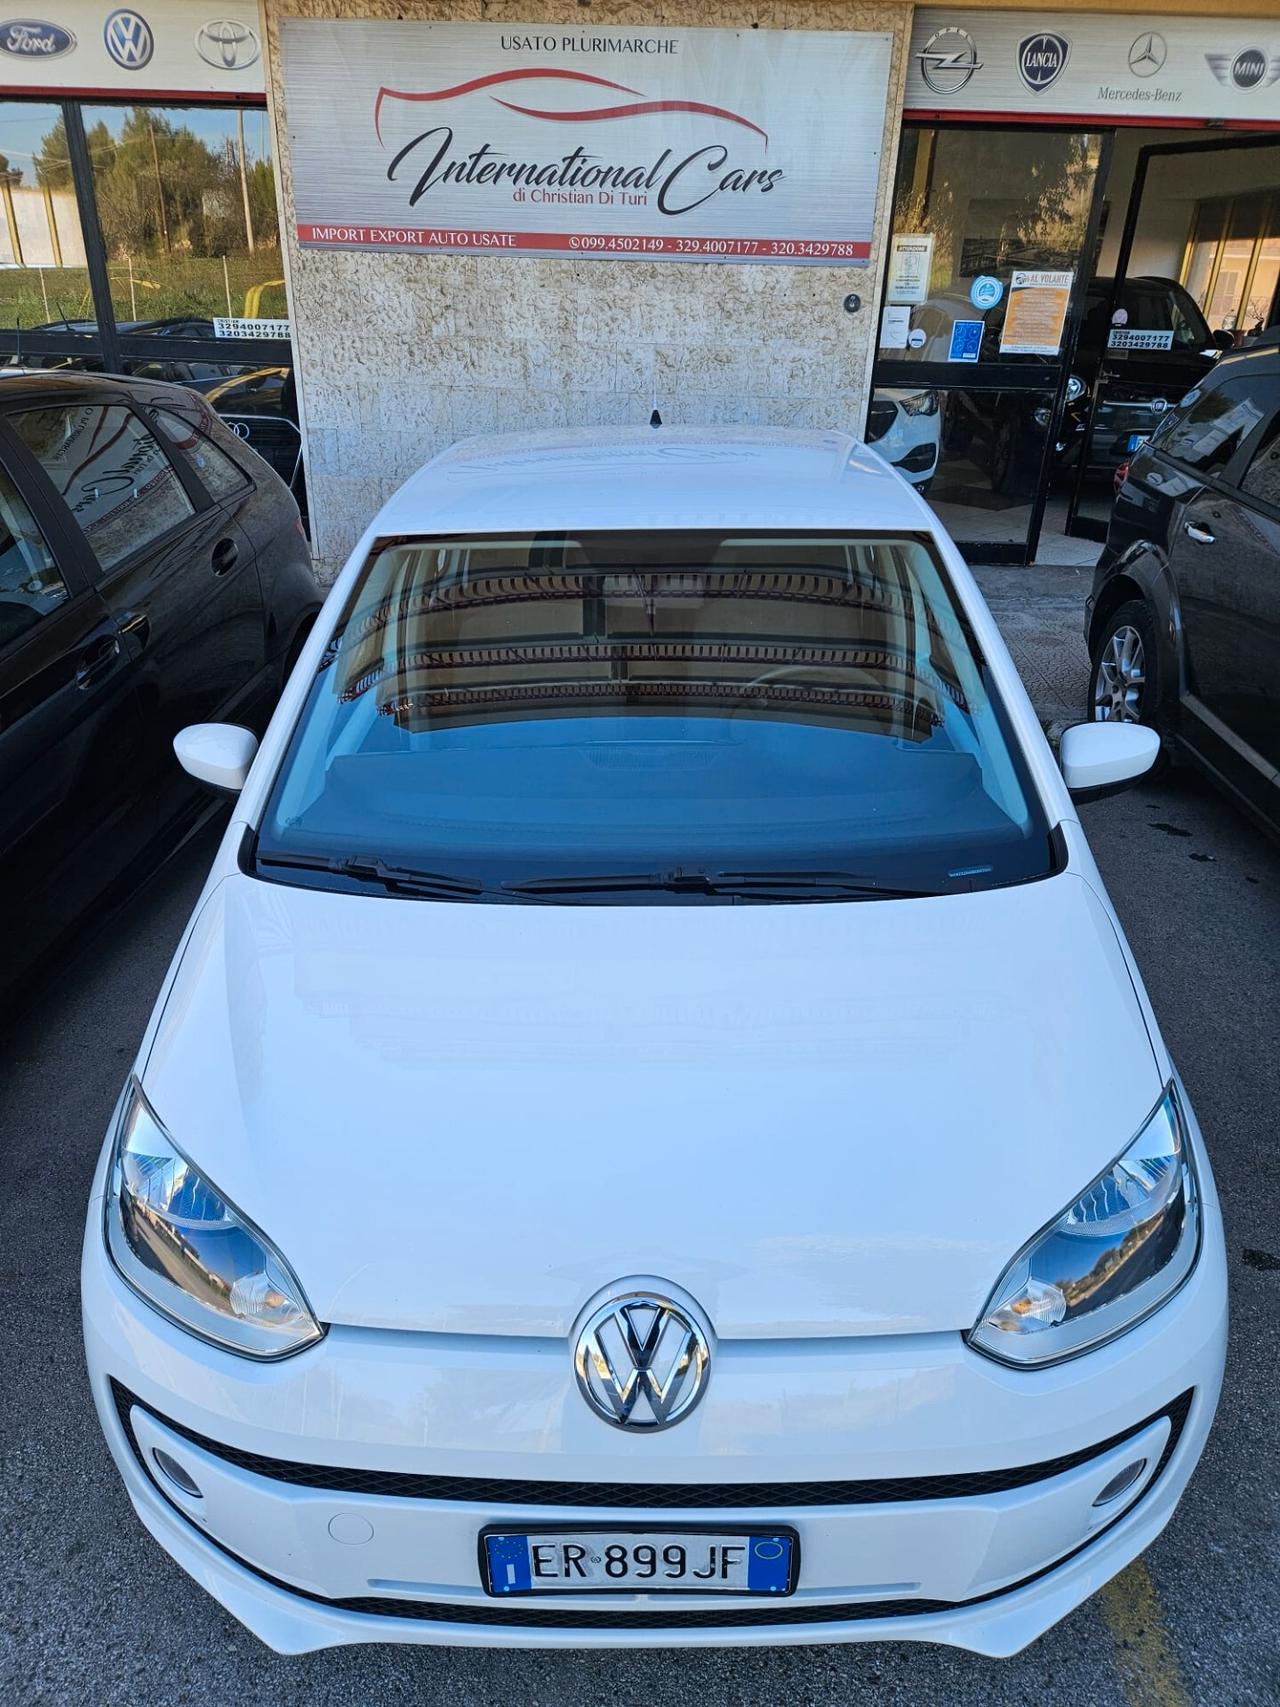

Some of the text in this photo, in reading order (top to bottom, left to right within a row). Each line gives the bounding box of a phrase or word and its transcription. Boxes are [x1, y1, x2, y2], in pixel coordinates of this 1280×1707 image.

[6, 25, 55, 52] Ford
[500, 35, 679, 54] USATO PLURIMARCHE
[1026, 51, 1058, 68] LANCIA
[1234, 61, 1265, 77] MINI
[1097, 86, 1183, 103] Mercedes-Benz
[387, 126, 786, 216] International Cars
[512, 187, 648, 206] di Christian Di Turi
[312, 227, 517, 247] IMPORT EXPORT AUTO USATE
[581, 236, 664, 251] 099.4502149
[675, 239, 759, 253] 329.4007177
[770, 242, 854, 256] 320.3429788
[218, 323, 290, 331] 3294007177
[219, 330, 291, 338] 3203429788
[1111, 341, 1168, 349] 3203429788
[1112, 334, 1170, 342] 3294007177
[531, 1544, 746, 1579] ER 899 JF
